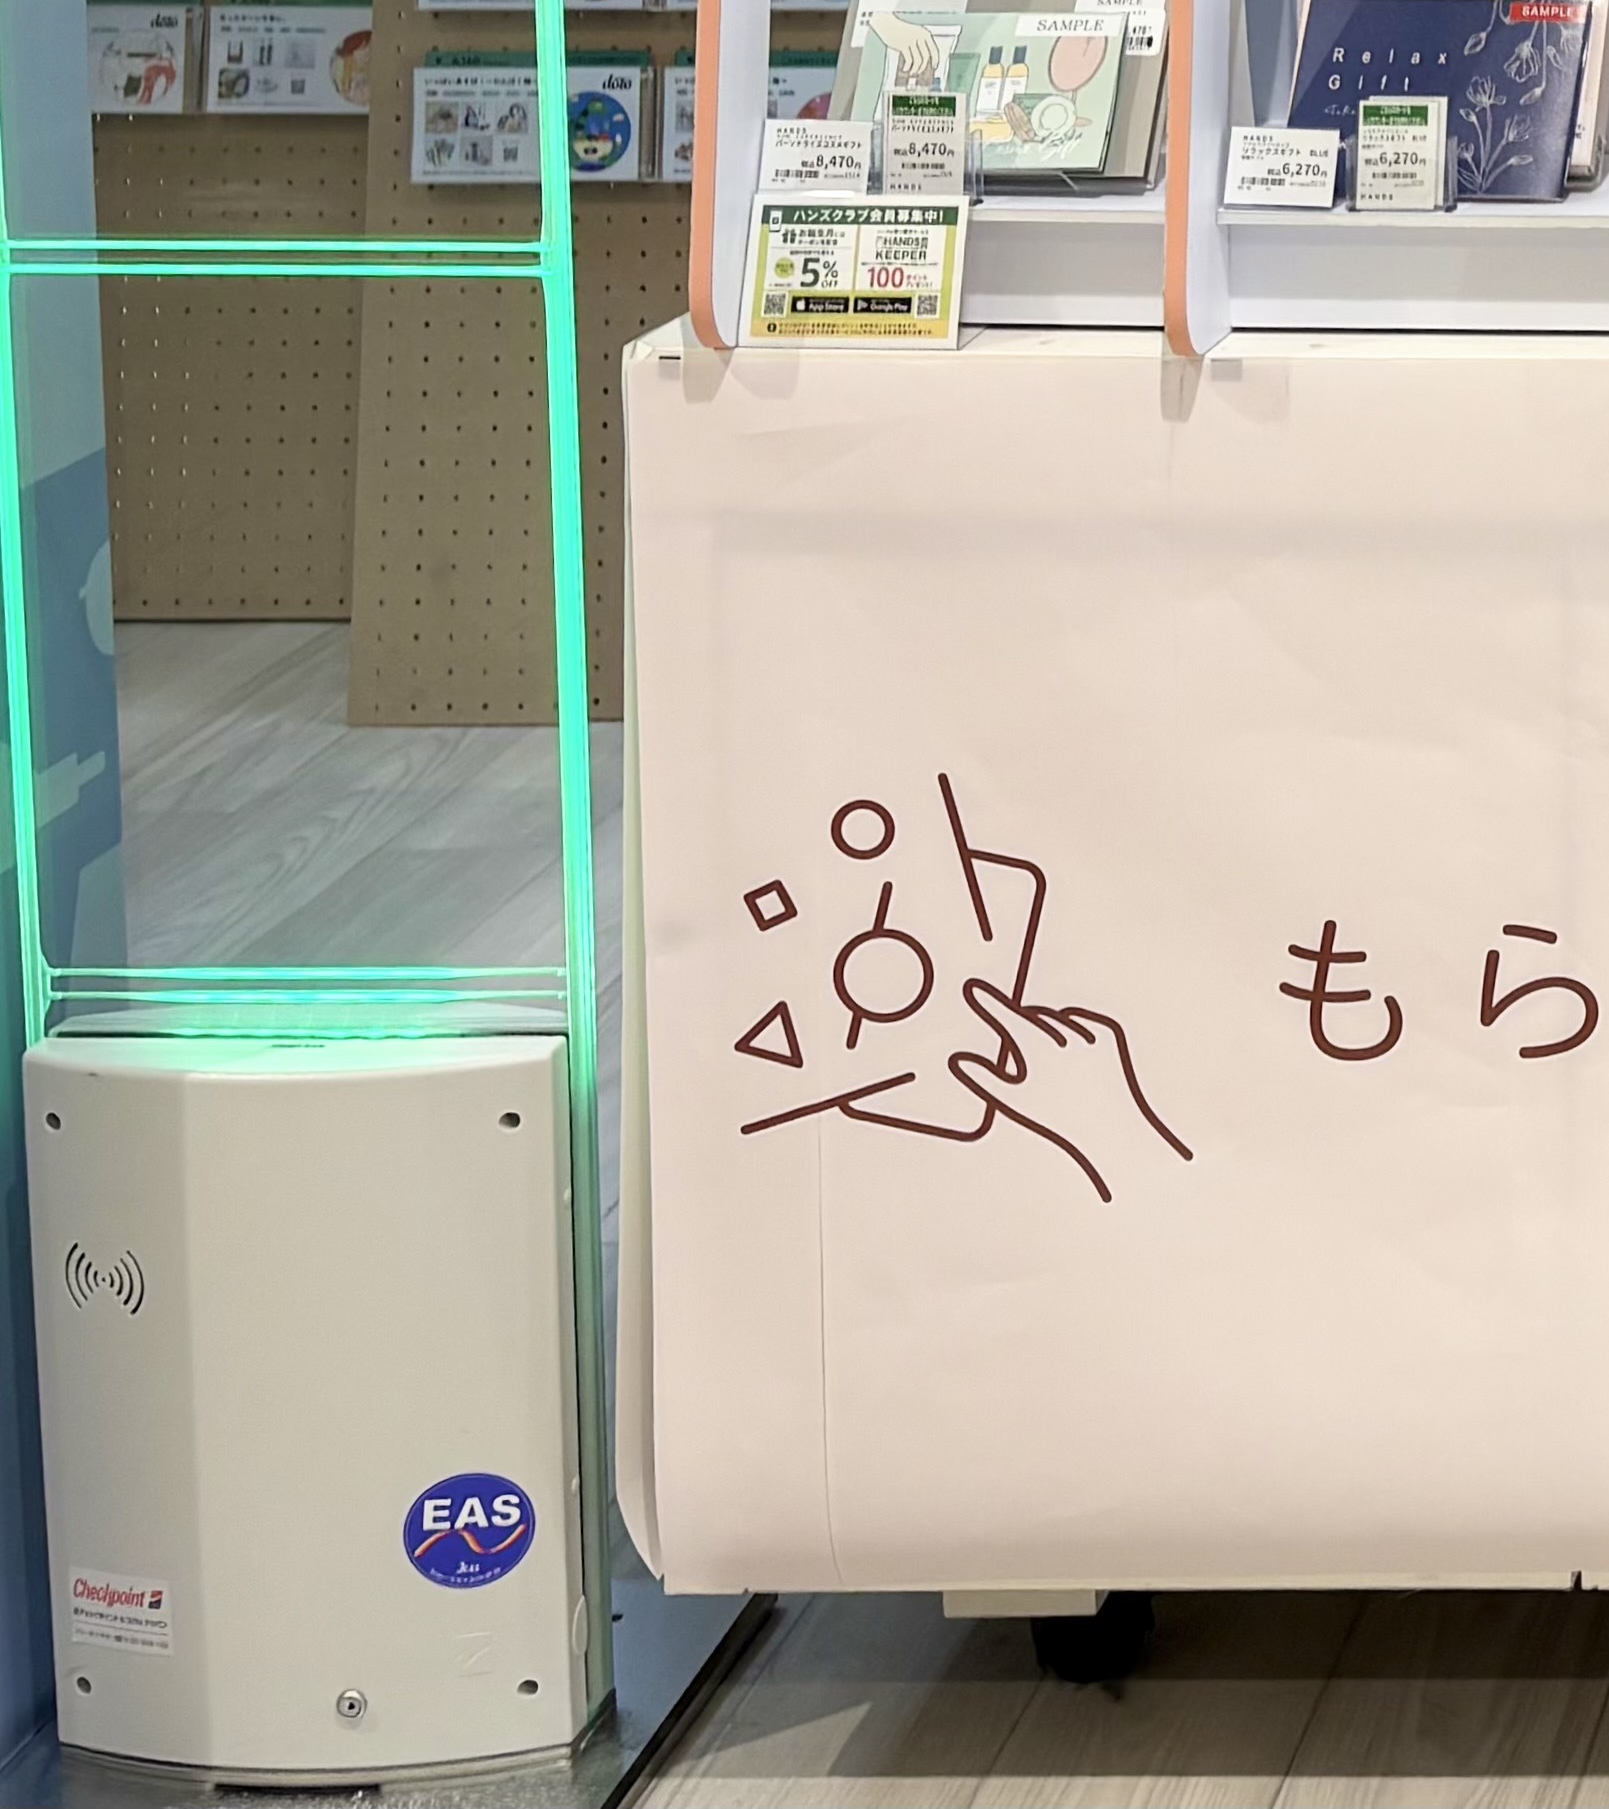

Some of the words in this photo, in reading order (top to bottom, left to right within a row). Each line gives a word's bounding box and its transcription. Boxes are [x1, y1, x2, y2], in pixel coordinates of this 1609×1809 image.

[1521, 5, 1574, 18] SAMPLE
[1037, 18, 1104, 32] SAMPLE
[1332, 47, 1448, 65] Relax
[1328, 73, 1411, 92] Gift
[875, 249, 927, 261] KEEPER
[867, 267, 905, 289] 100
[421, 1494, 521, 1531] EAS
[72, 1576, 148, 1610] Checkpoint
